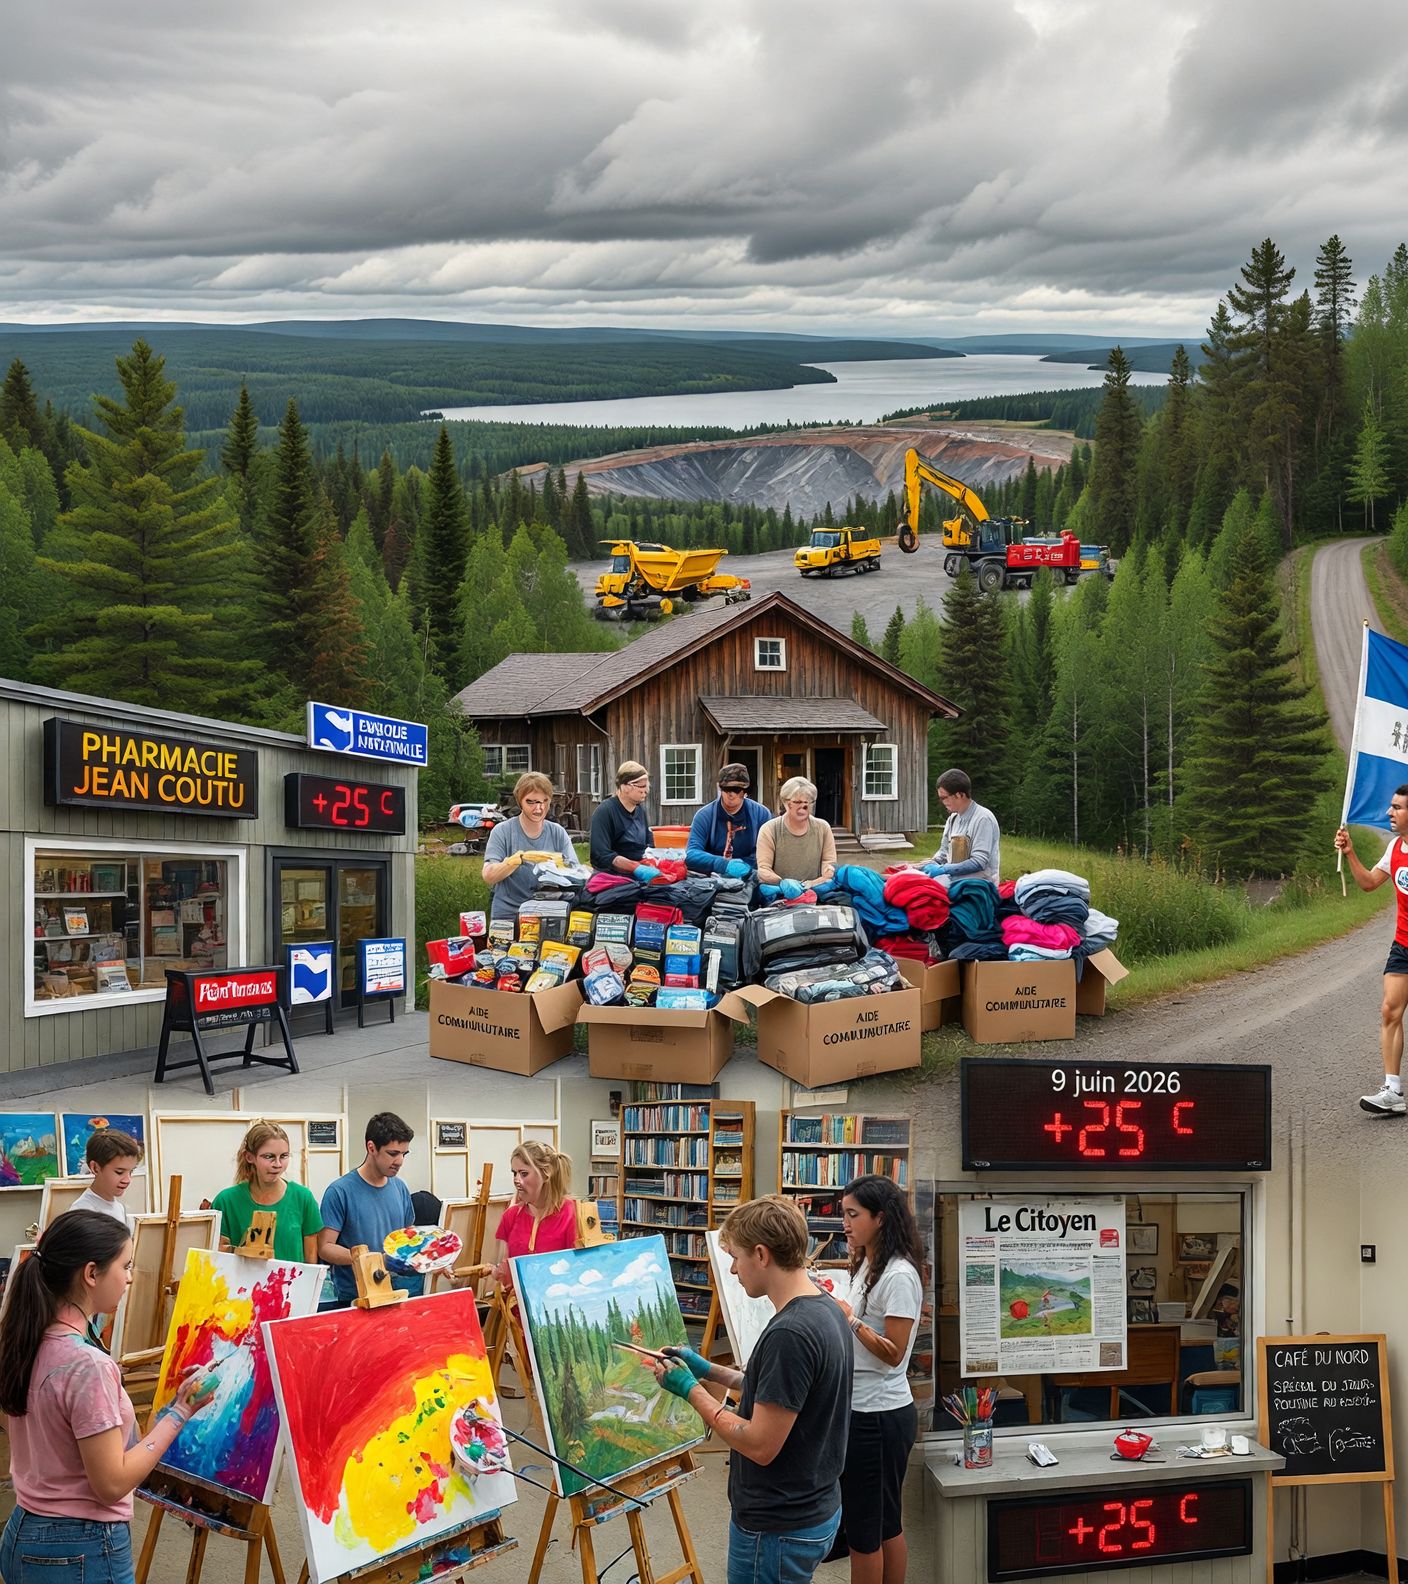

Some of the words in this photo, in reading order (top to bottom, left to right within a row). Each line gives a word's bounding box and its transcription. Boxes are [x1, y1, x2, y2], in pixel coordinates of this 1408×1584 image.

[82, 732, 238, 779] PHARMACIE
[73, 765, 149, 800] JEAN
[158, 774, 244, 808] COUTU
[468, 1006, 489, 1019] AIDE
[855, 1010, 880, 1023] AIDE
[1051, 1069, 1066, 1092] 9
[1072, 1069, 1116, 1098] juin
[1123, 1070, 1182, 1094] 2026
[1172, 1101, 1195, 1134] C
[984, 1207, 1011, 1233] Le
[1015, 1207, 1097, 1239] Citoyen
[1274, 1347, 1309, 1368] CAFÉ
[1314, 1350, 1332, 1366] DU
[1335, 1349, 1369, 1365] NORD
[1322, 1380, 1337, 1392] DU
[1180, 1493, 1198, 1524] C
